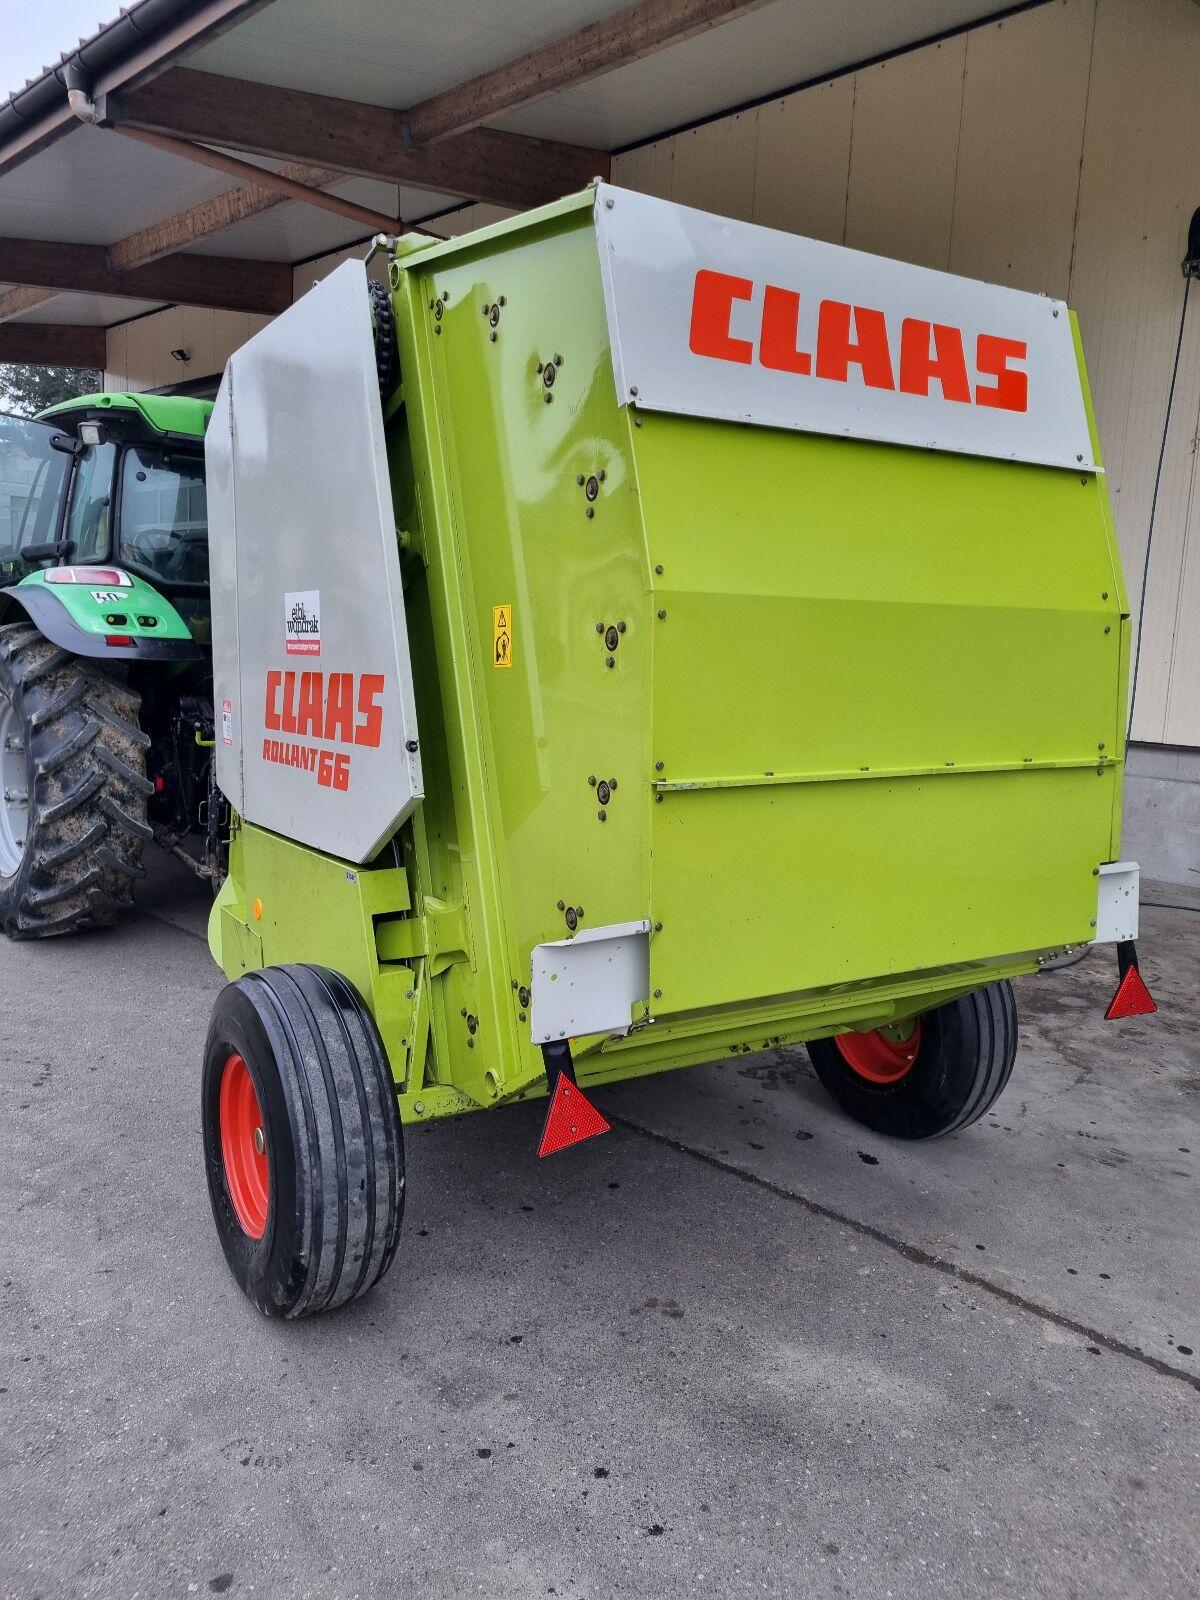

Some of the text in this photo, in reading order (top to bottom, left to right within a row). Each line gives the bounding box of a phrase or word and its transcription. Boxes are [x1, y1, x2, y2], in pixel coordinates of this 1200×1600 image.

[690, 269, 1027, 412] CLAAS
[265, 671, 384, 747] CLAAS
[263, 739, 350, 791] ROLLANT 66
